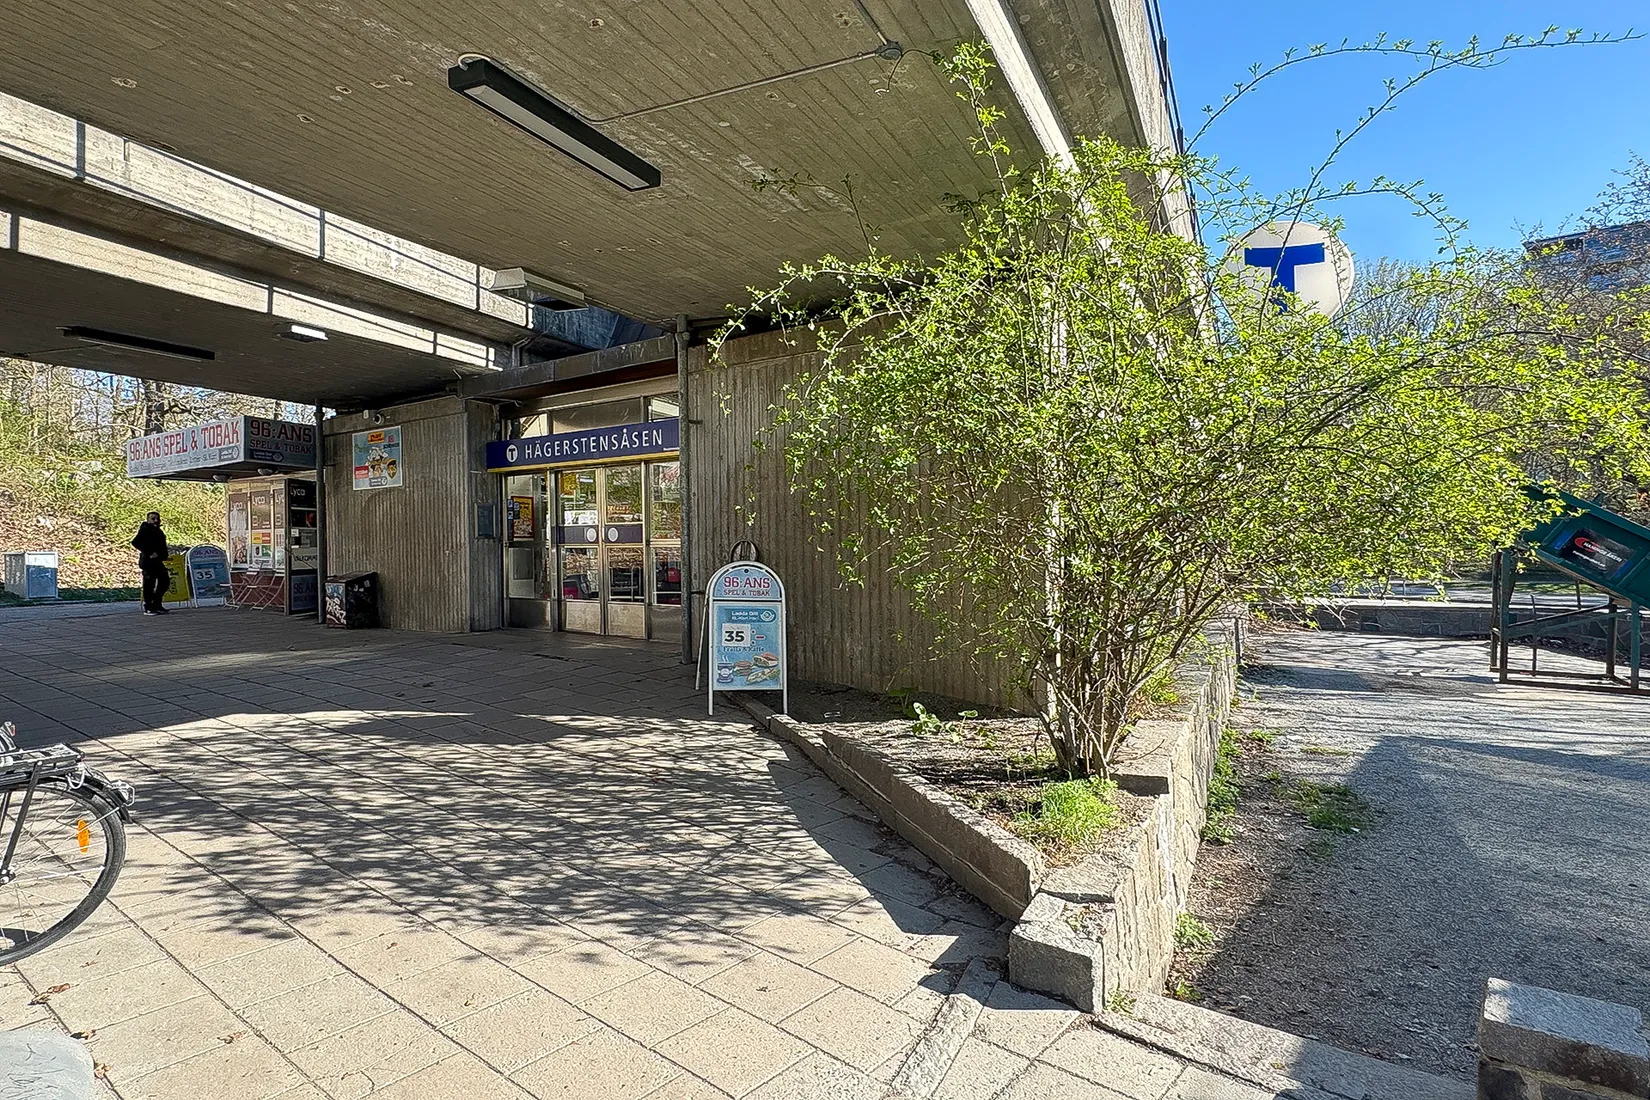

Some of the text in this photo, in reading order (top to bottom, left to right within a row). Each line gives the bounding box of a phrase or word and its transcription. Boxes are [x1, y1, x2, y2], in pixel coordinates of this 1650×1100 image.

[250, 419, 312, 443] 96:ANS
[129, 421, 240, 462] 96:ANS SPEL & TOBAK
[250, 440, 272, 450] SPEL
[284, 443, 312, 454] TOBAK
[525, 428, 662, 460] HÄGERSTENSÅSEN
[290, 486, 306, 496] Lyca
[252, 495, 266, 505] Lyca
[197, 570, 213, 580] 35
[723, 576, 771, 589] 96:ANS
